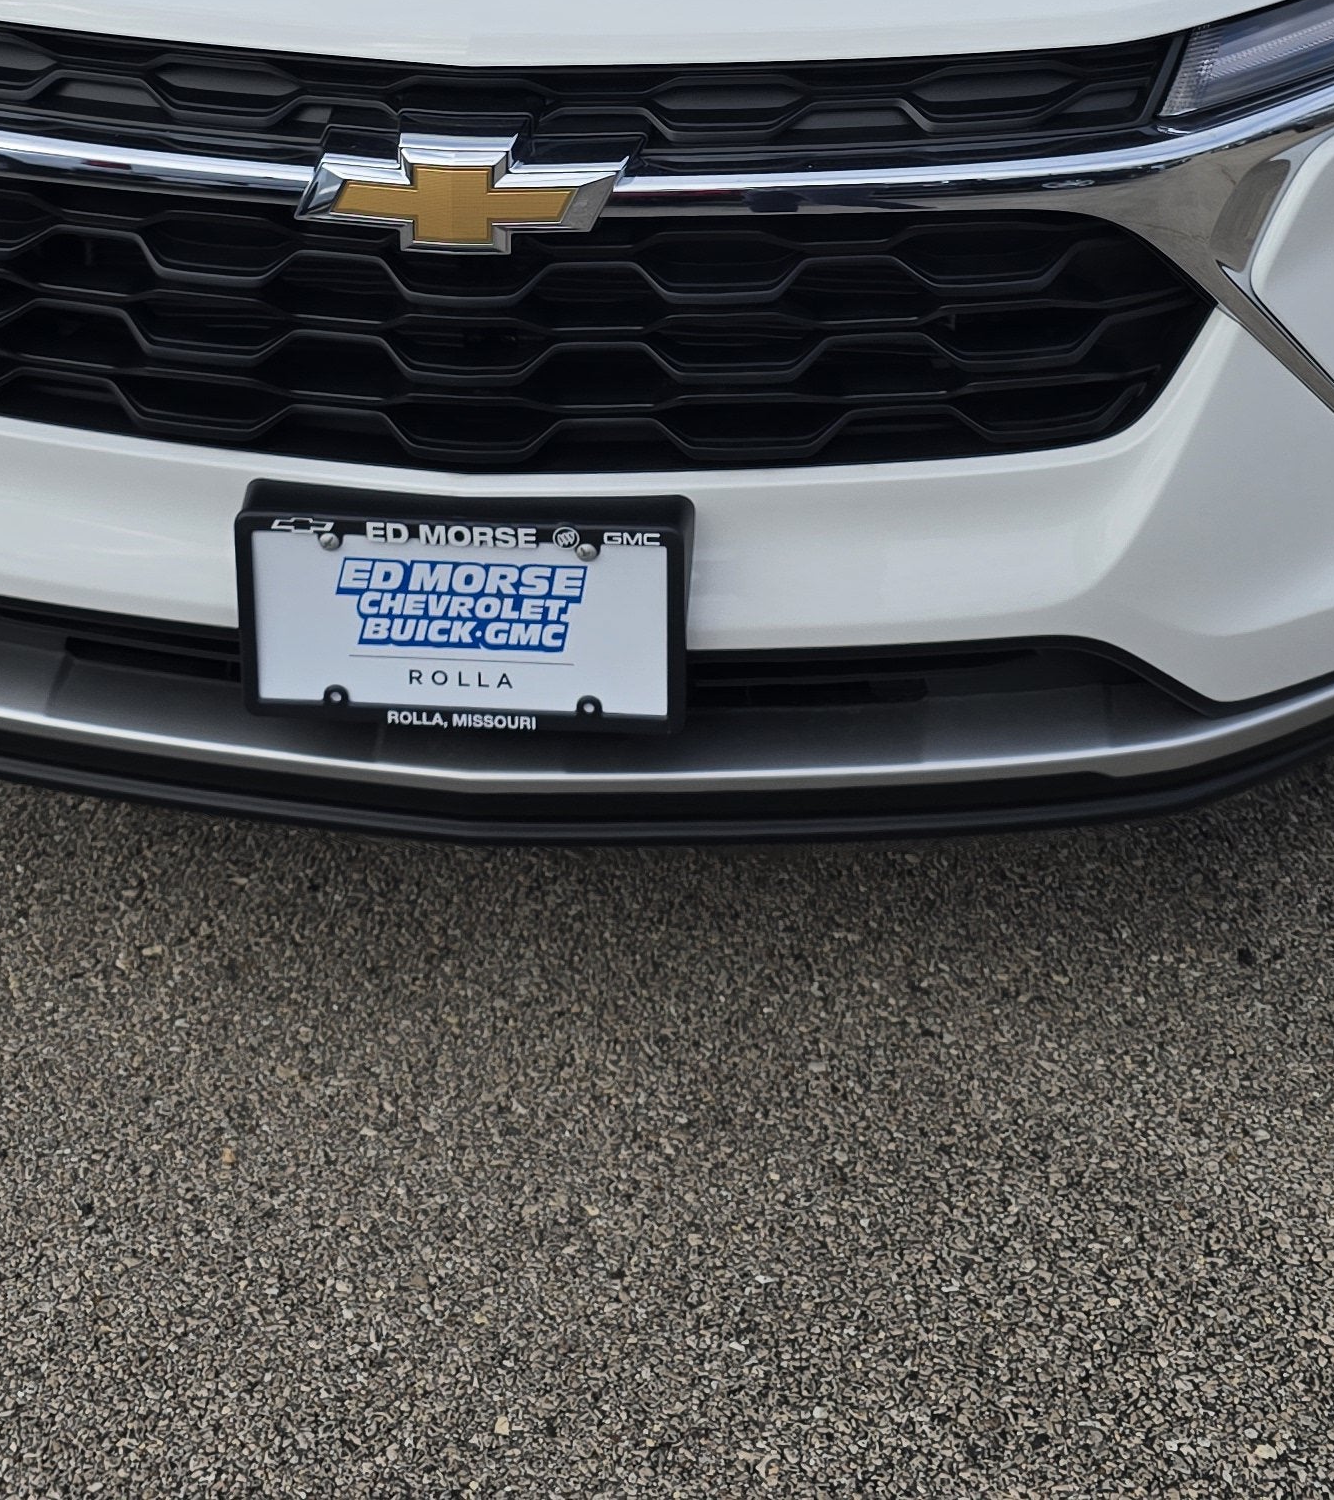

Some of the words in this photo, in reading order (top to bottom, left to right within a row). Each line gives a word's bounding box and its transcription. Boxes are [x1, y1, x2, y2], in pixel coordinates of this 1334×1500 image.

[365, 521, 409, 545] ED
[418, 523, 537, 549] MORSE
[602, 531, 661, 547] GMC
[339, 559, 404, 590] ED
[407, 561, 586, 598] MORSE
[408, 670, 513, 688] ROLLA
[387, 710, 449, 728] ROLLA,
[452, 713, 537, 731] MISSOURI
